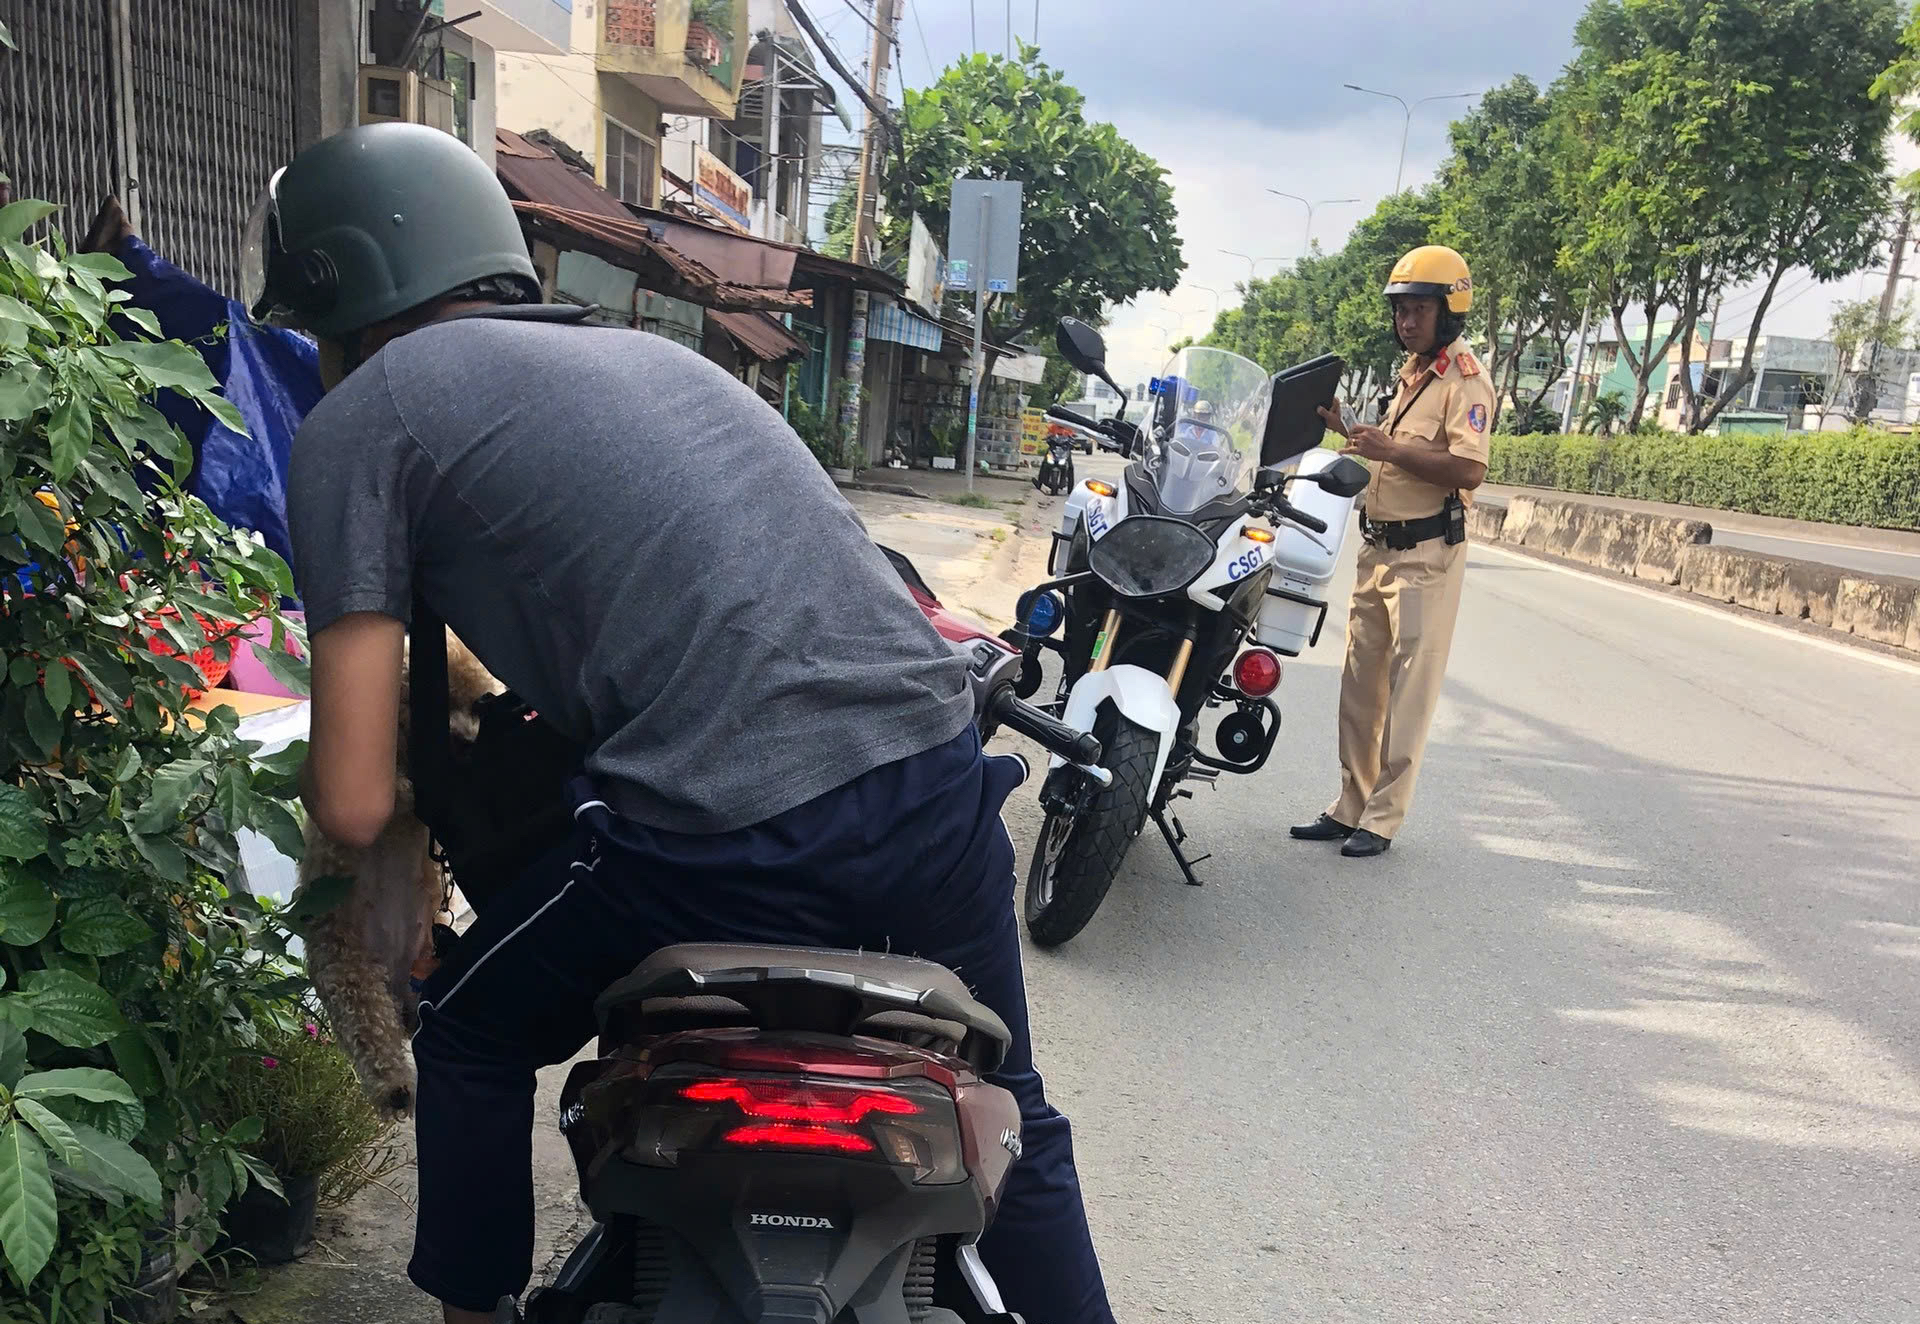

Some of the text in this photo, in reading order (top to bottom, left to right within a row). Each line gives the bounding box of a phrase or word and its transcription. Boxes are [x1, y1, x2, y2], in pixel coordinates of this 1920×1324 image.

[1088, 498, 1108, 536] CSGT
[1228, 545, 1264, 580] CSGT
[750, 1213, 834, 1229] HONDA
